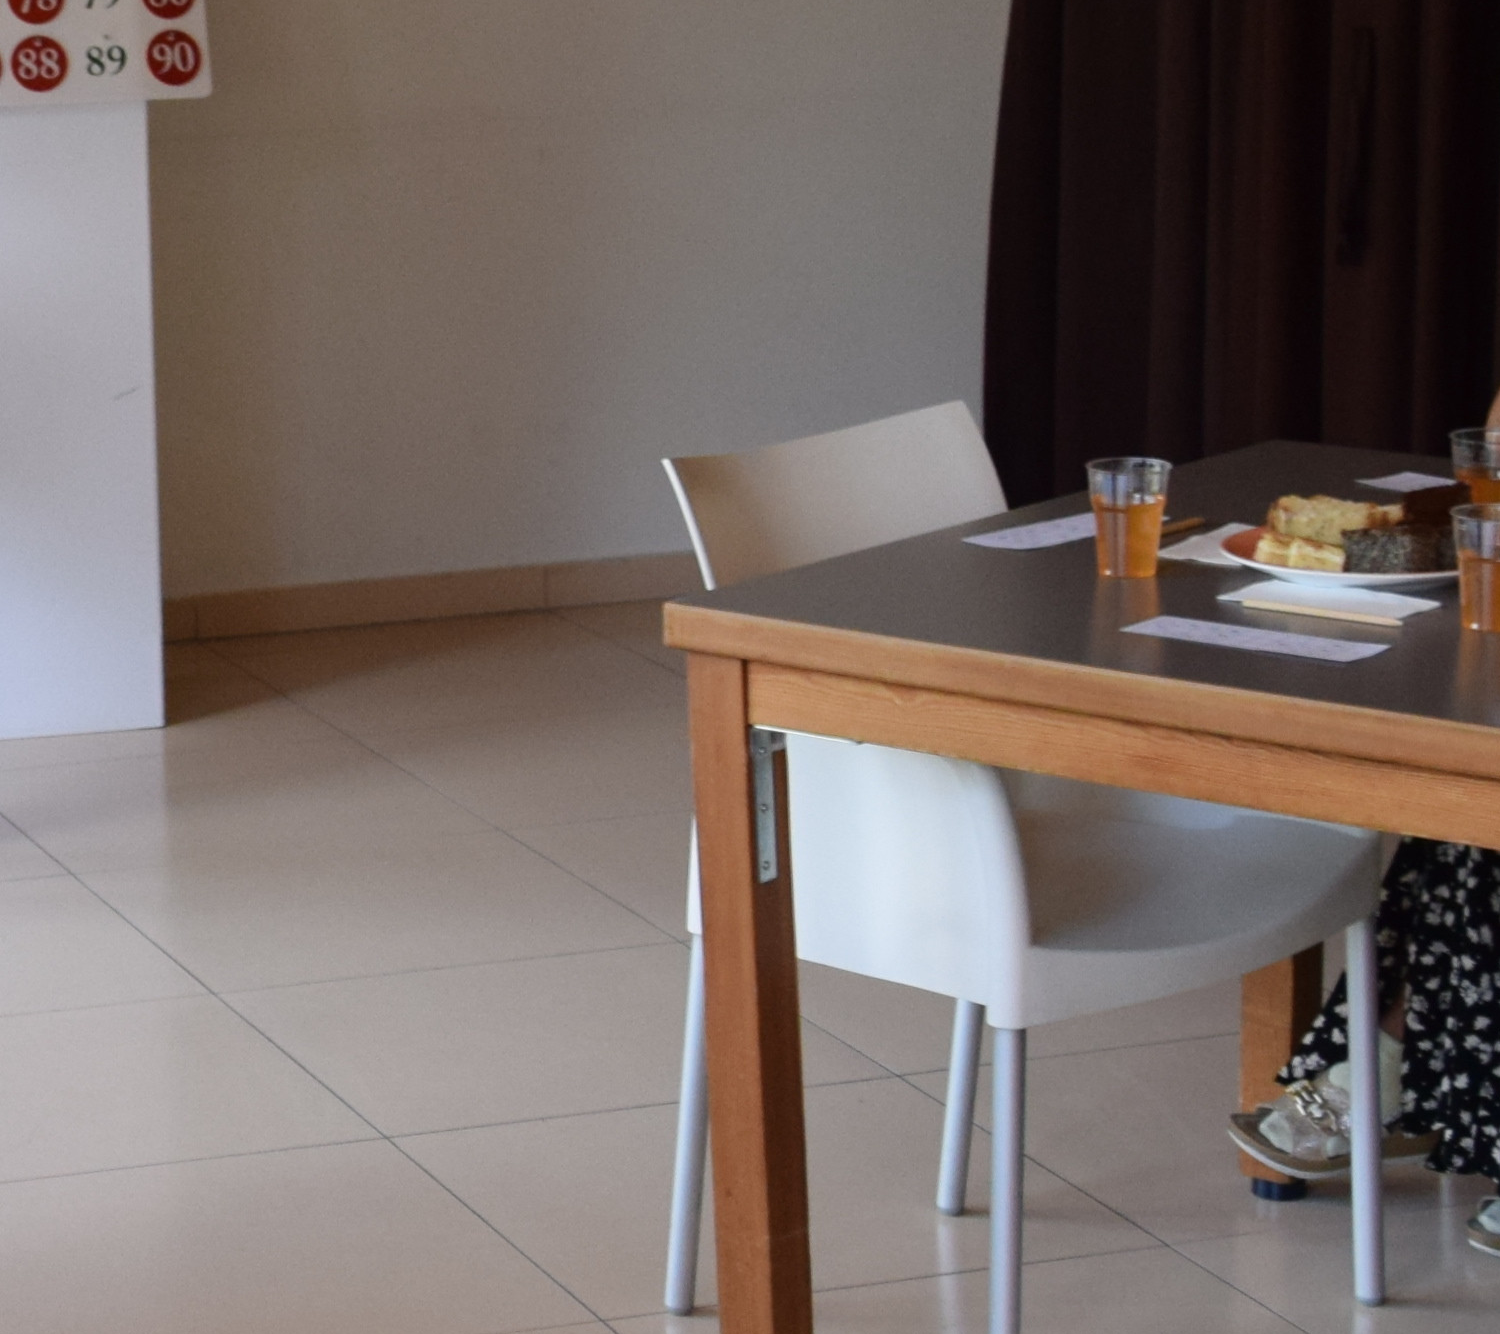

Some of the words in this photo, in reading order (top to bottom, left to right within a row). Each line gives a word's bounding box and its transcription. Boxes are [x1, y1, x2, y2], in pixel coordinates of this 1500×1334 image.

[18, 48, 60, 80] 88
[86, 45, 127, 76] 89
[152, 42, 194, 72] 90
